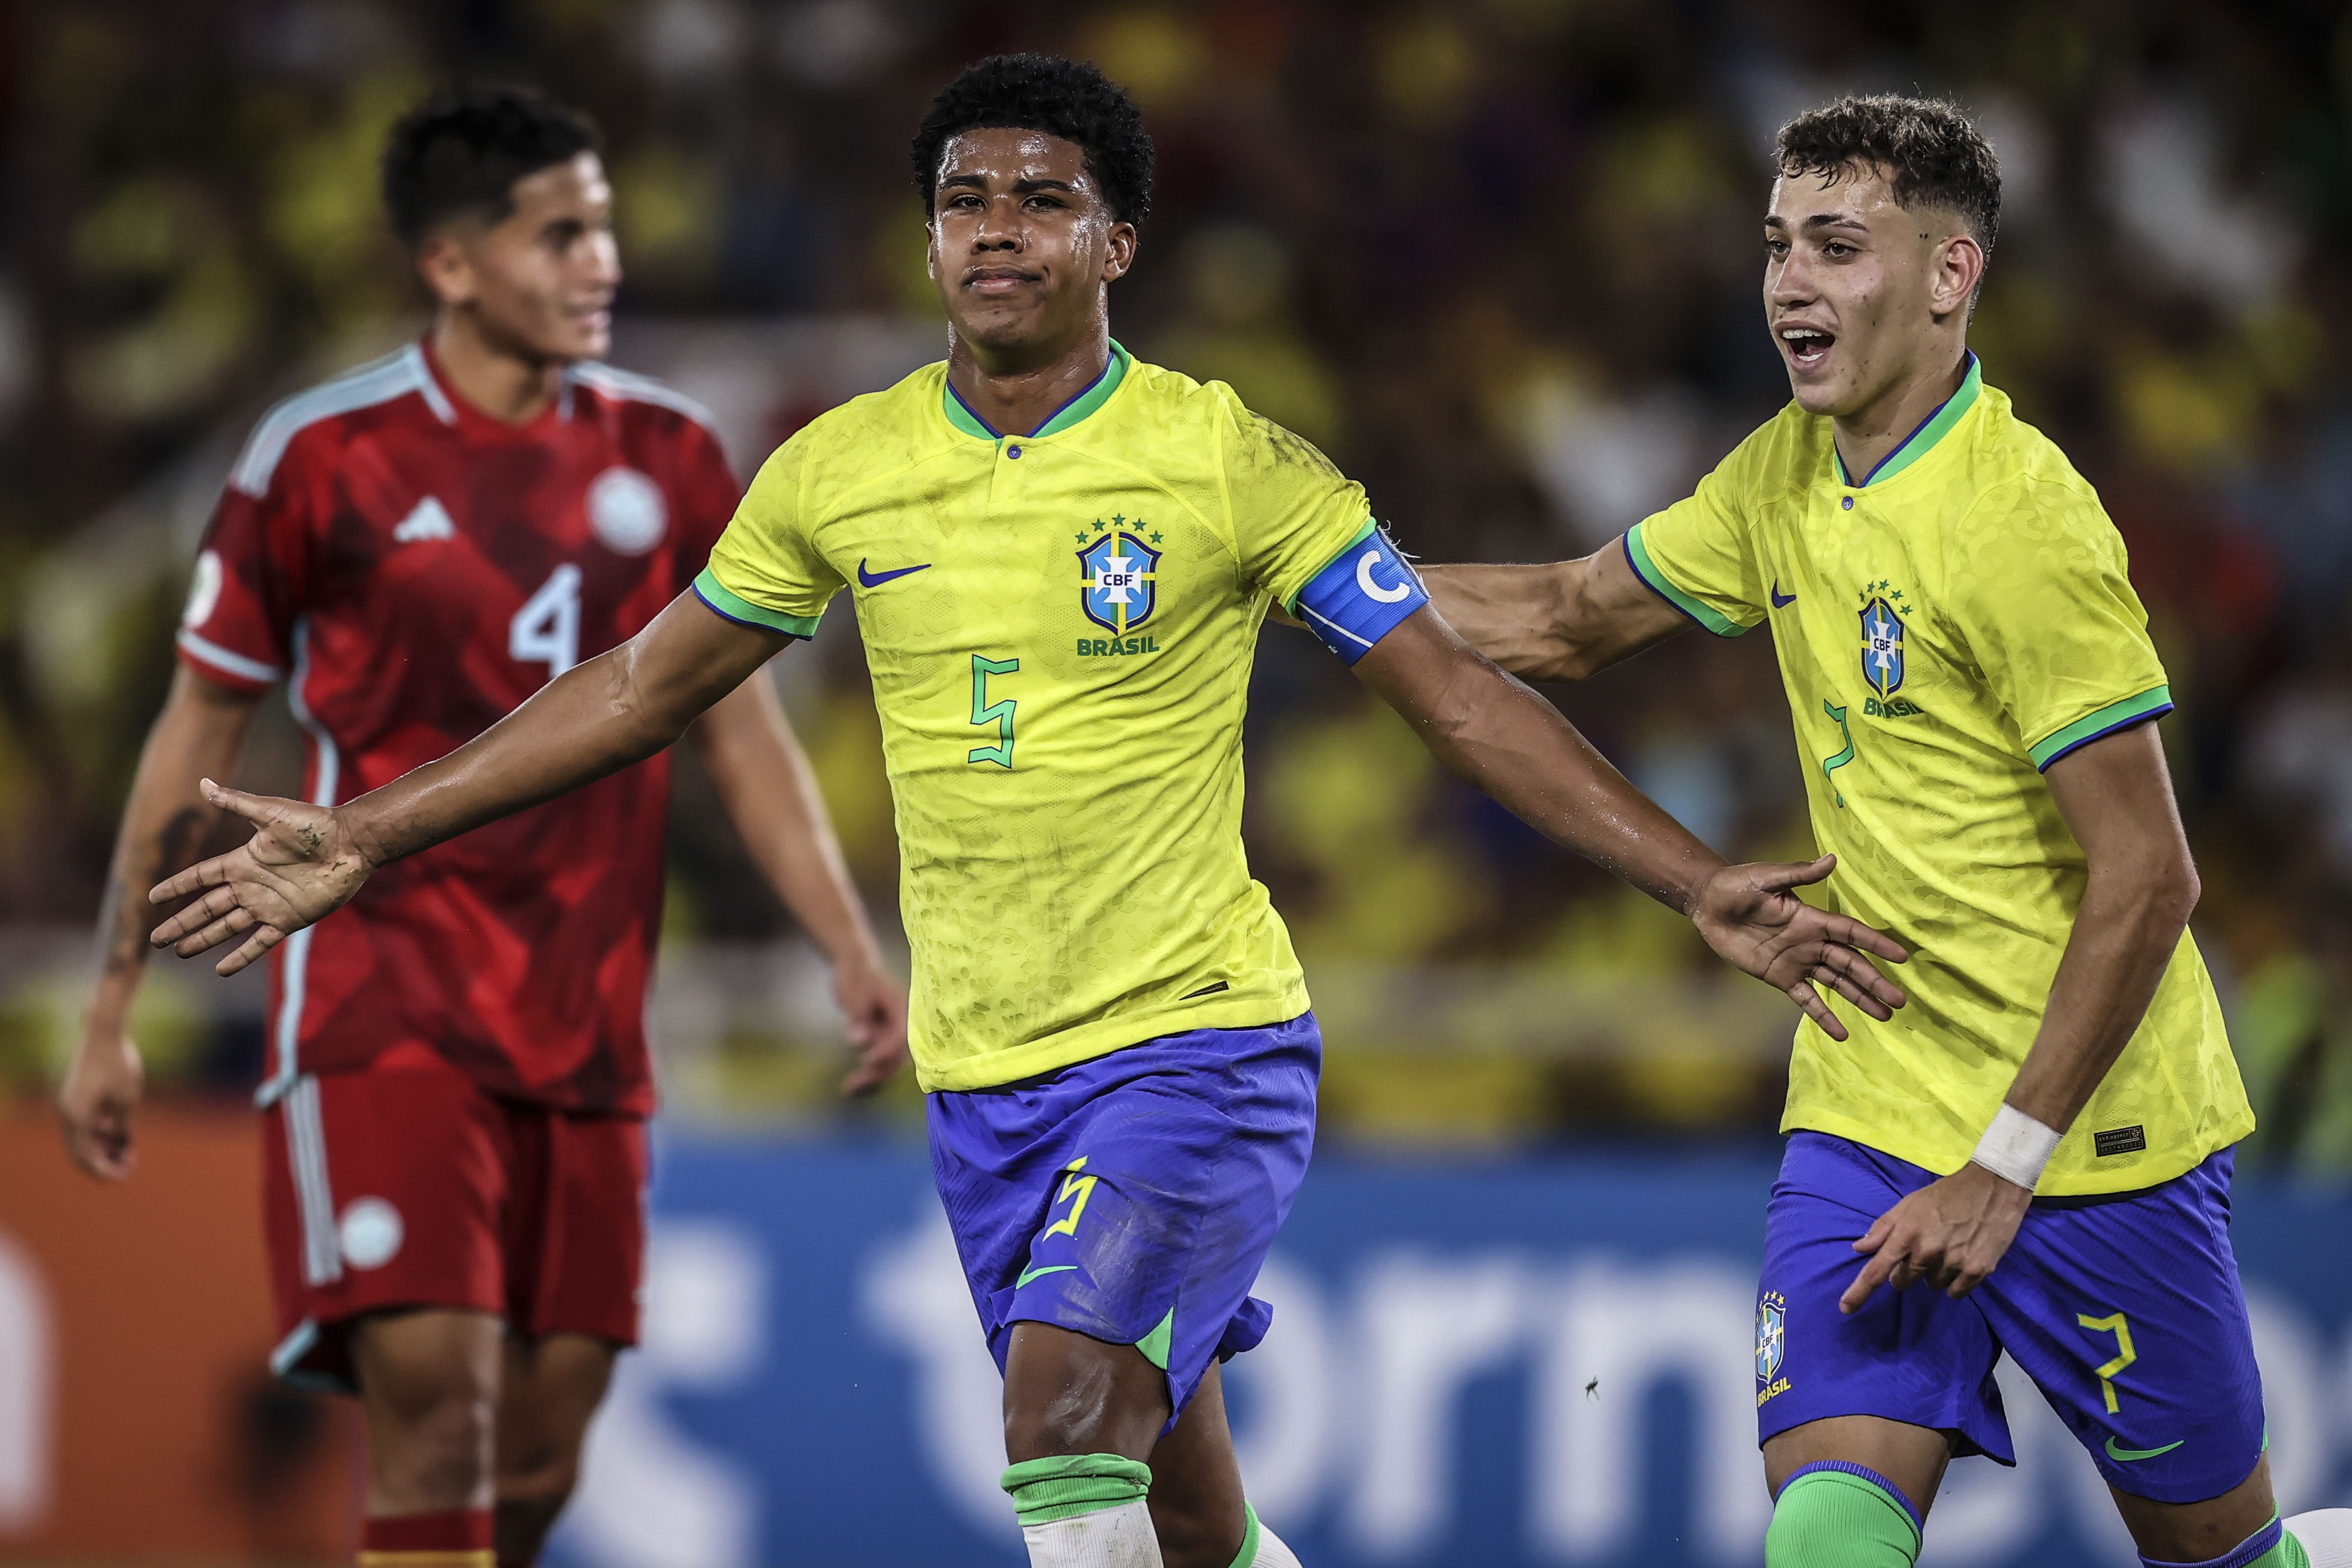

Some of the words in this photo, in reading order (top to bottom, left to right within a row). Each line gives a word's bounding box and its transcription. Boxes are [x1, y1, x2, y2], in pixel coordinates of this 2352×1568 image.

[1103, 574, 1134, 586] CBF
[1357, 550, 1411, 603] C
[509, 561, 582, 678] 4
[1077, 636, 1160, 657] BRASIL
[1873, 637, 1891, 653] CBF
[968, 653, 1020, 770] 5
[1863, 697, 1926, 718] BRASIL
[1043, 1154, 1098, 1243] 5
[1762, 1334, 1773, 1348] CBF
[2076, 1312, 2137, 1415] 7
[1757, 1376, 1792, 1407] BRASIL
